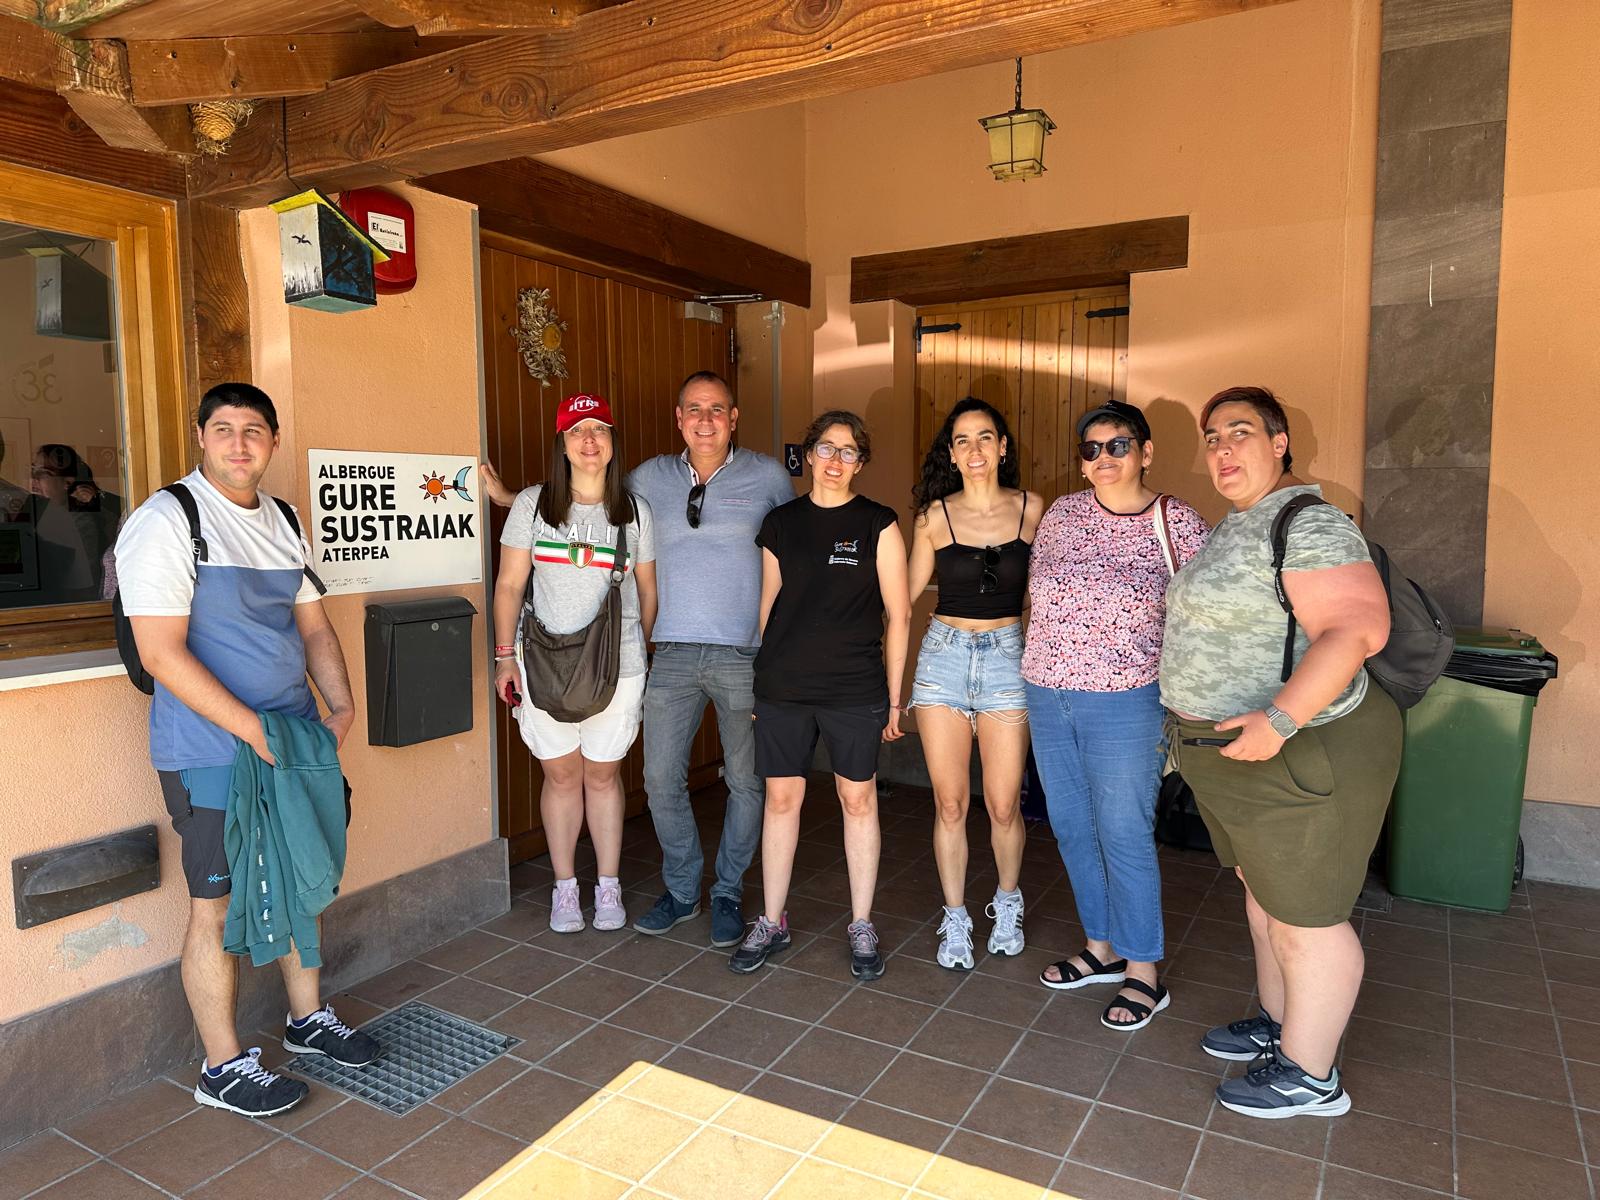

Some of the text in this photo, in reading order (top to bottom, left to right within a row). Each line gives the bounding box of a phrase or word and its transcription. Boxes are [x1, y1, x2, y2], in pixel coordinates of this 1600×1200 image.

[319, 464, 396, 480] ALBERGUE
[319, 483, 396, 511] GURE
[321, 513, 475, 544] SUSTRAIAK
[322, 546, 390, 562] ATERPEA
